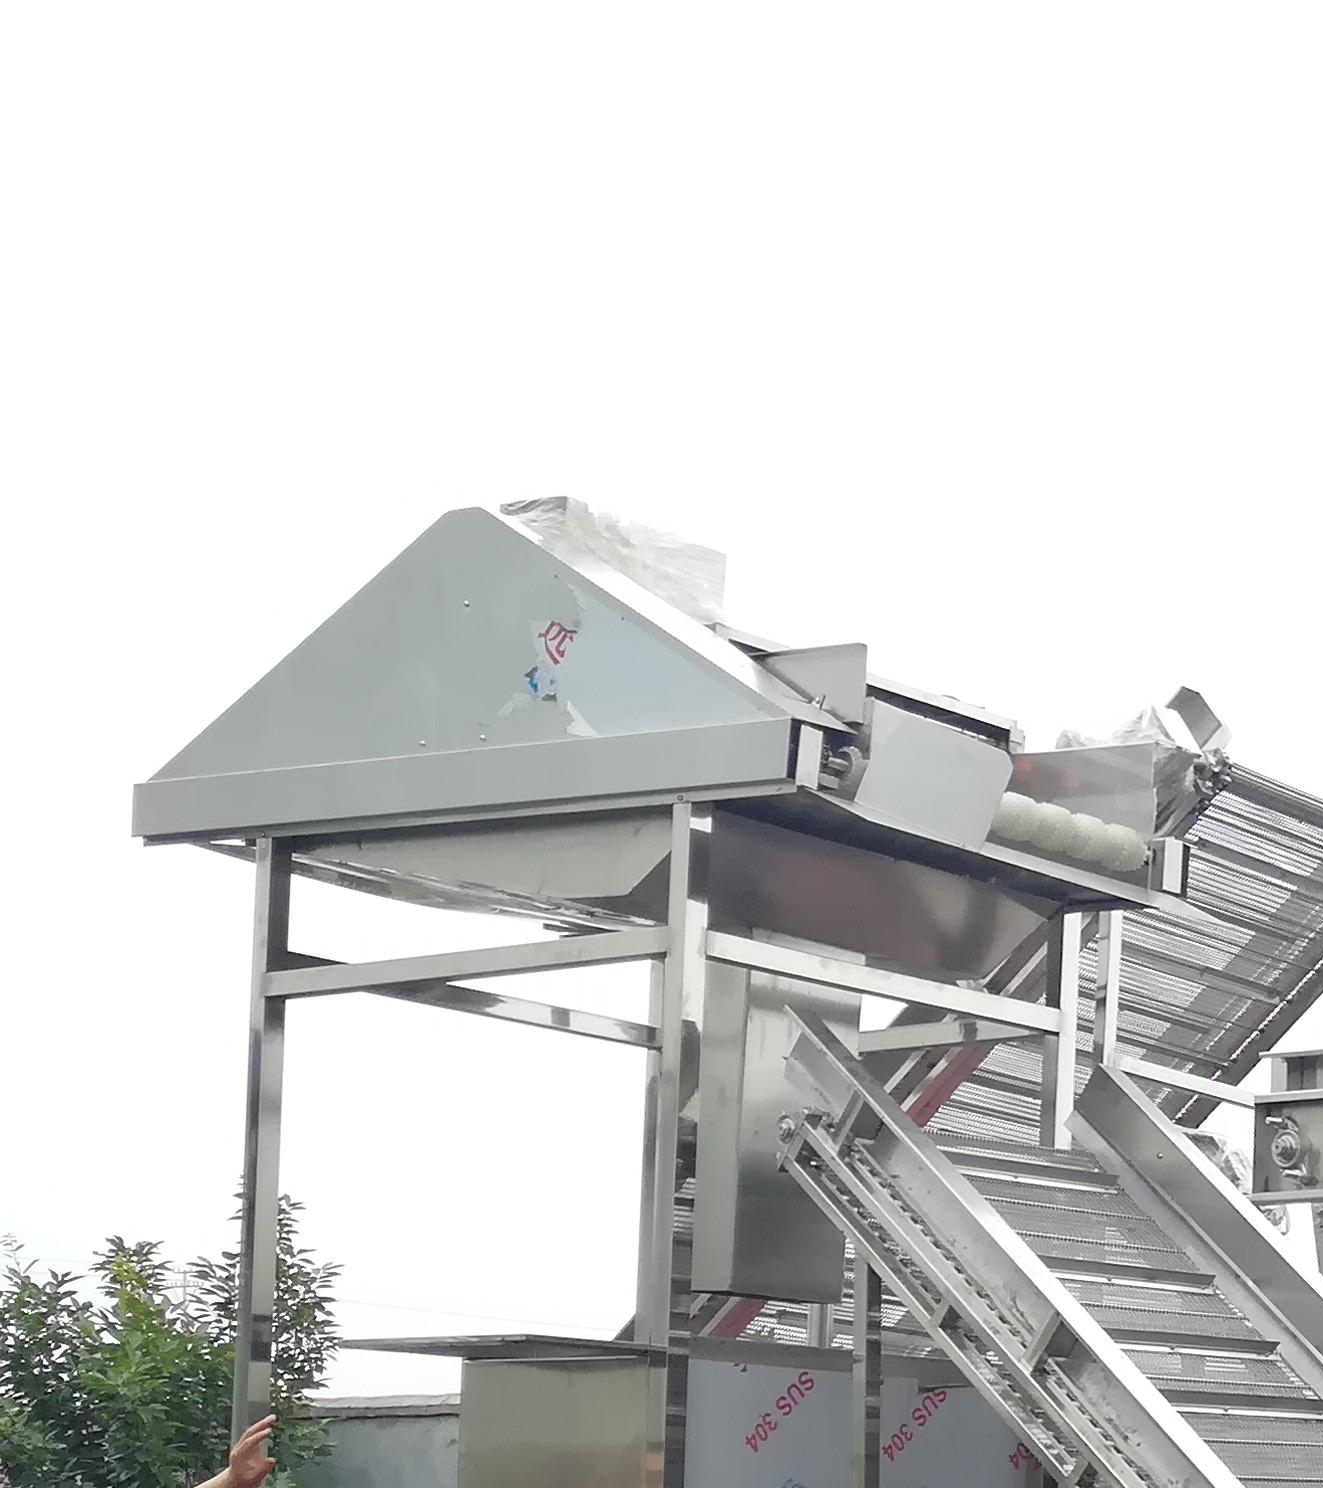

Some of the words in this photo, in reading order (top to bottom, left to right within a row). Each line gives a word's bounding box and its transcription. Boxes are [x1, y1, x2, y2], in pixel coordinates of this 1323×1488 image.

[776, 1371, 815, 1417] SUS
[912, 1389, 947, 1429] SUS
[745, 1413, 778, 1454] 304
[882, 1423, 914, 1462] 304
